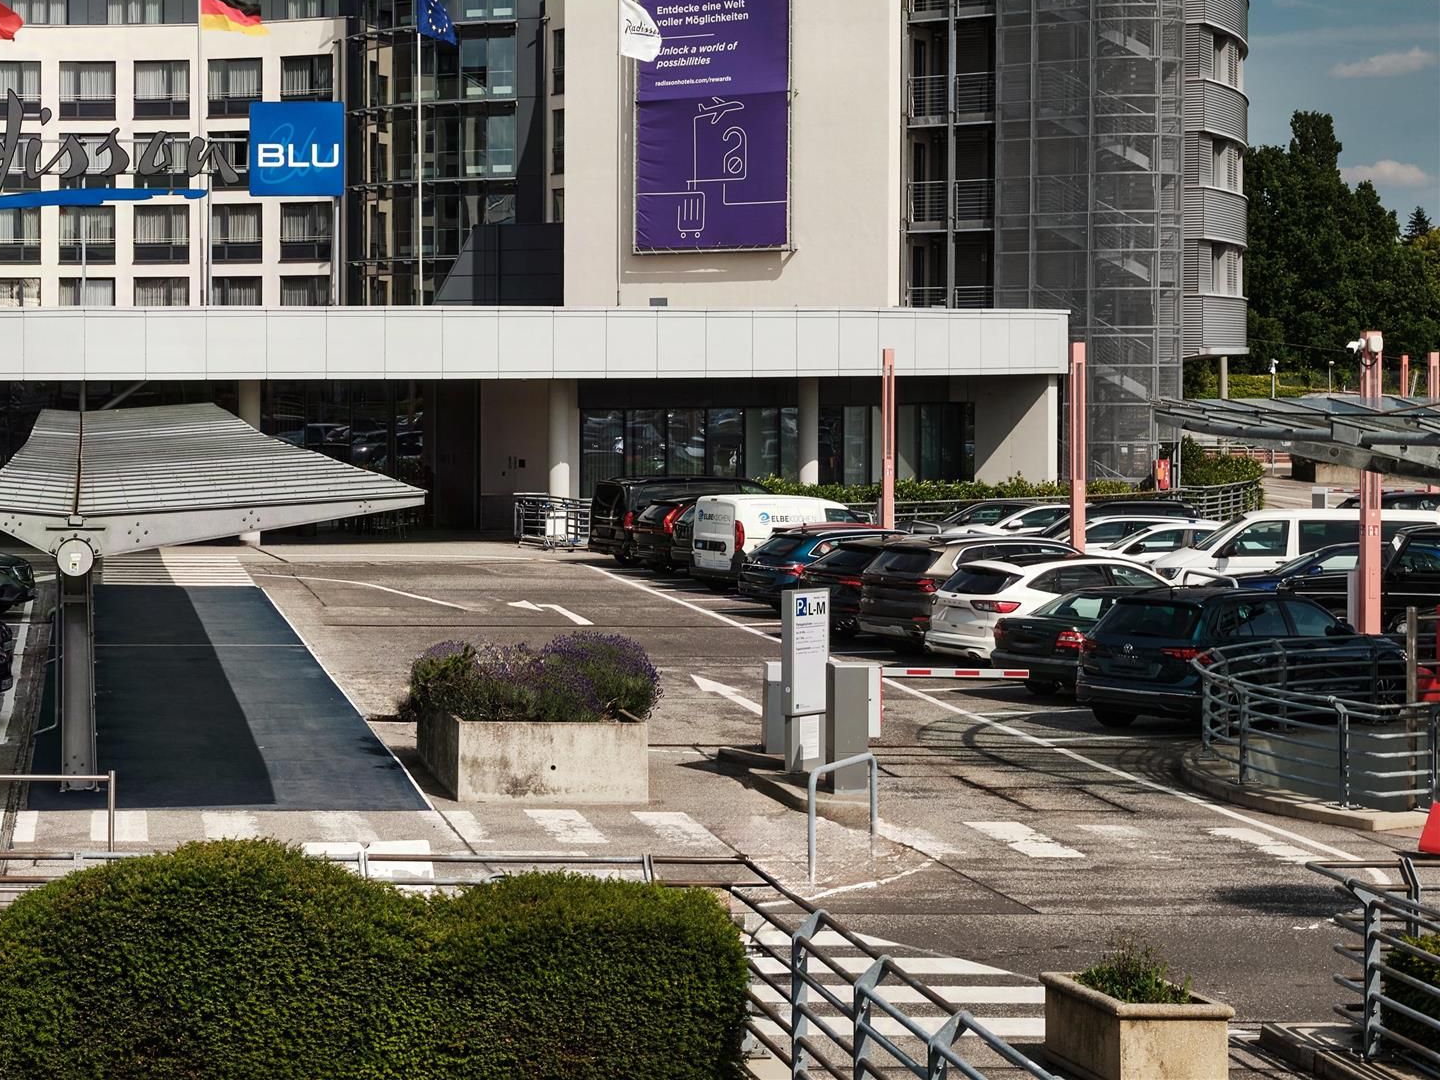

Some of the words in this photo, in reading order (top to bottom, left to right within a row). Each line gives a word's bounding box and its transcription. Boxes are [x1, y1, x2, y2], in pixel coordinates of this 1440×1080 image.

[656, 3, 700, 15] Entdecke
[701, 2, 721, 11] eine
[723, 0, 745, 9] Welt
[656, 17, 683, 27] voller
[685, 12, 749, 26] Möglichkeiten
[658, 45, 689, 56] Unlock
[699, 41, 725, 52] world
[727, 40, 738, 50] of
[656, 56, 711, 70] possibilities
[655, 76, 732, 86] radissonhotels.com/rewards
[257, 143, 340, 169] BLU
[808, 601, 826, 616] L-M
